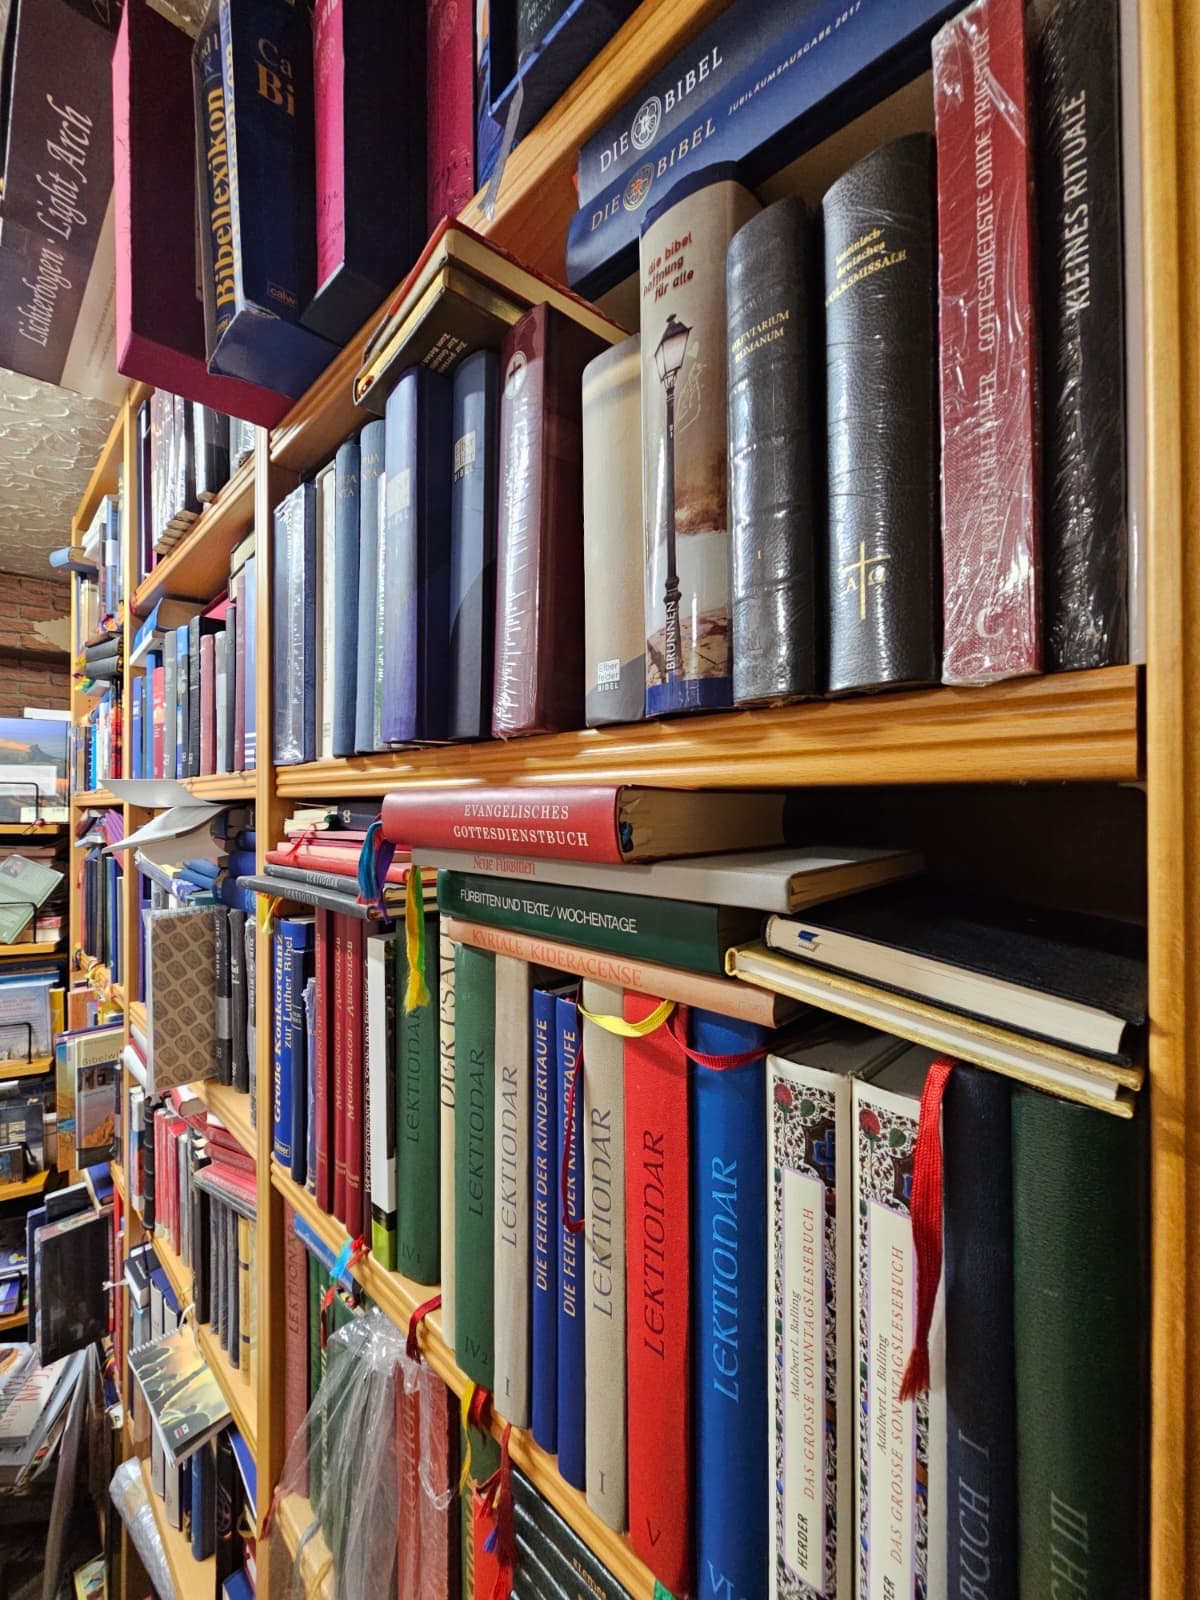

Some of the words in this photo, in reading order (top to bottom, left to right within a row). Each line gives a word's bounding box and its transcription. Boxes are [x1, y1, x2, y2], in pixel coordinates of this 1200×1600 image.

[728, 27, 832, 116] JUBILÄUMSAUSGABE
[835, 2, 862, 29] 2017
[974, 28, 991, 128] PRIESTER
[46, 93, 94, 183] Arch
[600, 133, 629, 174] DIE
[664, 47, 723, 114] BIBEL
[591, 194, 620, 232] DIE
[656, 118, 716, 178] BIBEL
[975, 130, 993, 189] OHNE
[1062, 89, 1088, 205] RITUALE
[36, 174, 87, 240] Light
[207, 87, 236, 307] Bibellexikon
[664, 231, 693, 262] bibel
[1064, 203, 1089, 314] KLEINES
[18, 250, 74, 347] Lichterbogen
[654, 281, 670, 303] für
[672, 269, 695, 290] alle
[735, 327, 785, 364] ROMANUM
[665, 601, 677, 670] BRUNNEN
[453, 825, 589, 848] GOTTESDIENSTBUCH
[463, 804, 570, 821] EVANGELISCHES
[473, 856, 494, 871] Neue
[460, 888, 501, 908] FÜRBITTEN
[502, 899, 520, 911] UND
[283, 936, 294, 974] Bibel
[472, 928, 522, 954] KYRIALE
[274, 935, 284, 1057] Konkordanz
[283, 975, 294, 1023] Luther
[284, 1029, 293, 1048] zur
[273, 1063, 282, 1123] Große
[536, 1018, 548, 1152] KINDERTAUFE
[469, 1047, 486, 1217] LEKTIONAR
[502, 1066, 518, 1249] LEKTIONAR
[536, 1155, 548, 1197] DER
[536, 1201, 548, 1255] FEIER
[591, 1107, 613, 1320] LEKTIONAR
[536, 1256, 548, 1291] DIE
[643, 1130, 666, 1361] LEKTIONAR
[563, 1279, 576, 1318] DIE
[712, 1156, 739, 1404] LEKTIONAR
[803, 1207, 815, 1390] SONNTAGSLESEBUCH
[790, 1289, 801, 1336] Balling
[791, 1347, 802, 1401] Adalbert
[876, 1332, 889, 1383] Balling
[803, 1394, 815, 1461] GROSSE
[877, 1396, 888, 1457] Adalbert
[803, 1470, 815, 1501] DAS
[889, 1448, 904, 1522] GROSSE
[797, 1512, 809, 1571] HERDER
[890, 1525, 903, 1566] DAS
[1050, 1489, 1089, 1554] III
